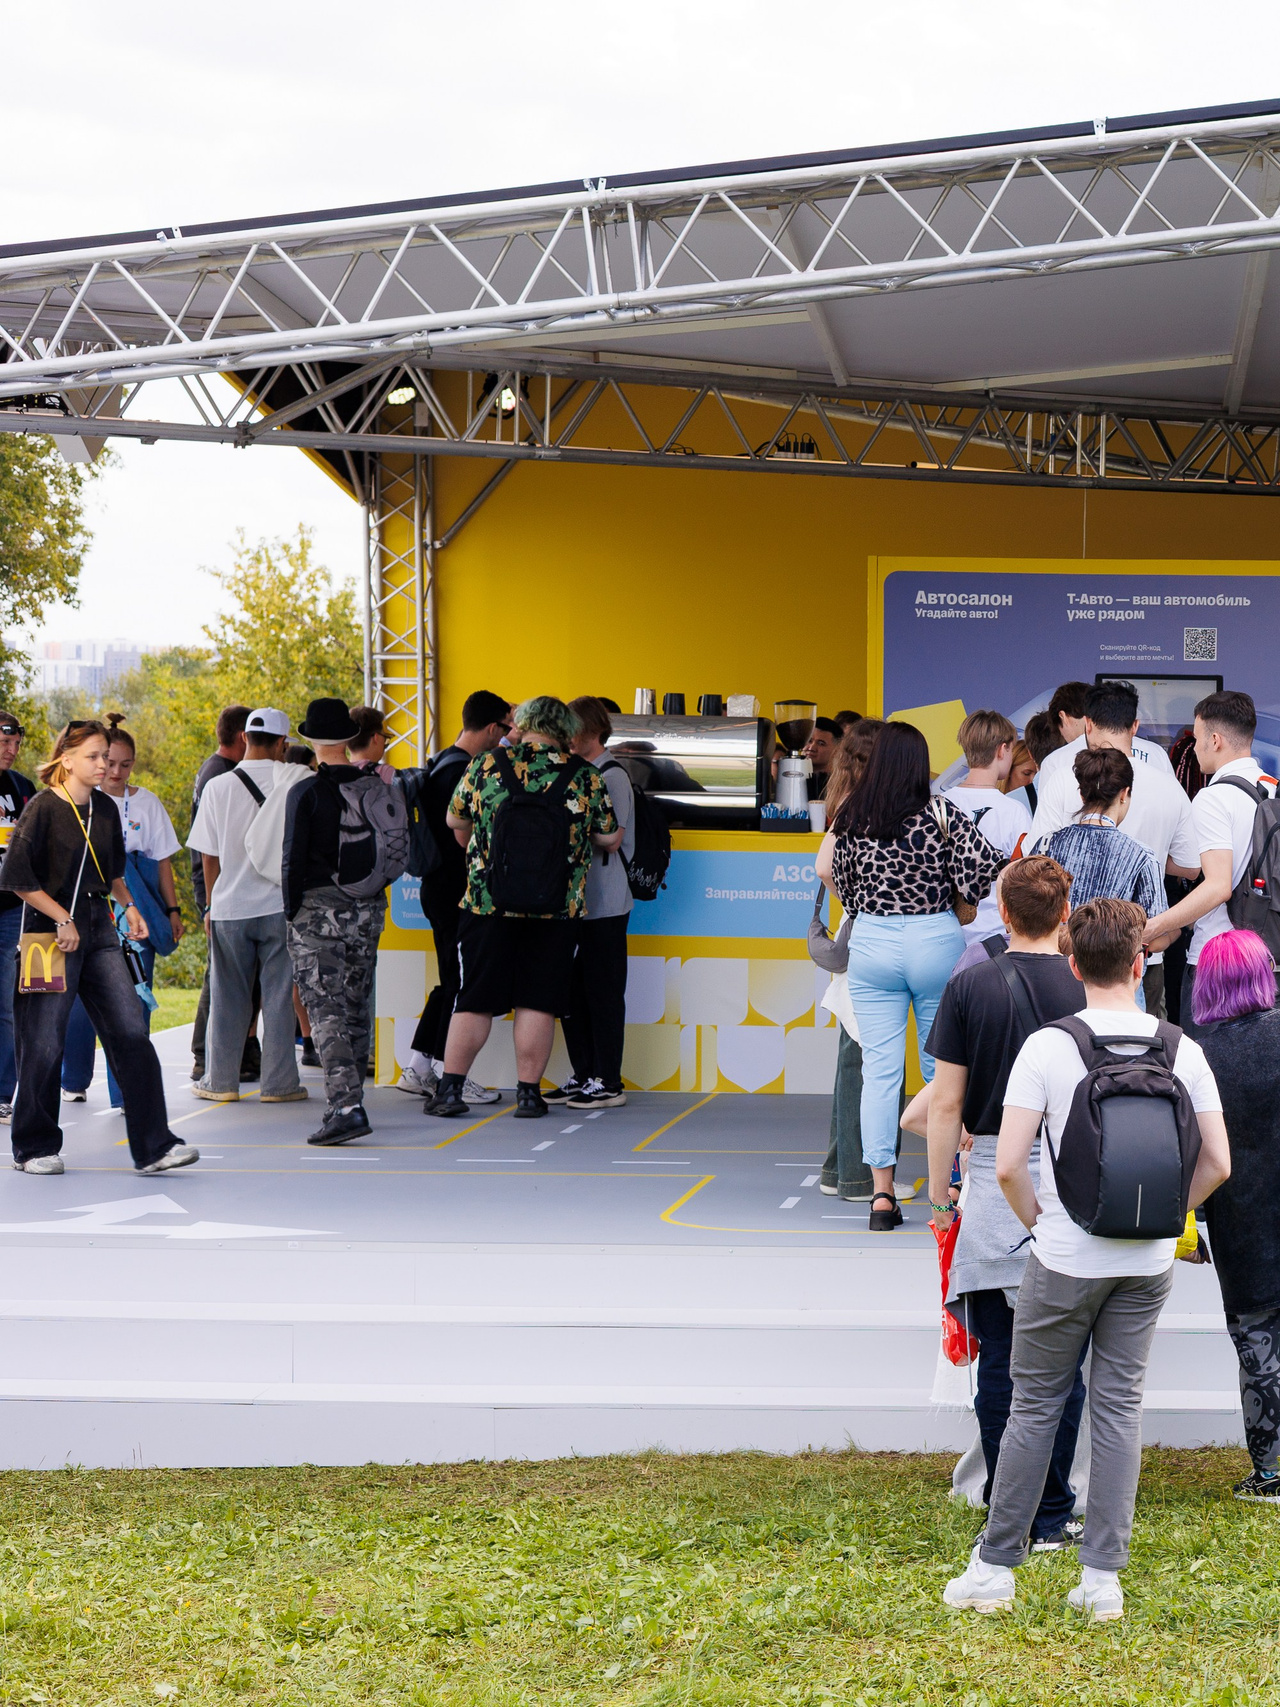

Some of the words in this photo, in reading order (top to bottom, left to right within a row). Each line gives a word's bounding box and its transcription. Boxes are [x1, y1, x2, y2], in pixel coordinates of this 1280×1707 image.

[915, 590, 1013, 606] Автосалон
[1067, 593, 1113, 605] Т-Авто
[1132, 596, 1160, 606] ваш
[1164, 594, 1251, 606] автомобиль
[915, 608, 967, 619] Угадайте
[969, 609, 998, 619] авто!
[1067, 610, 1096, 621] уже
[1098, 610, 1145, 621] рядом
[1099, 644, 1137, 652] Сканируйте
[1138, 644, 1161, 652] QR-код
[772, 865, 815, 882] АЗС
[705, 887, 815, 901] Заправляйтесь!
